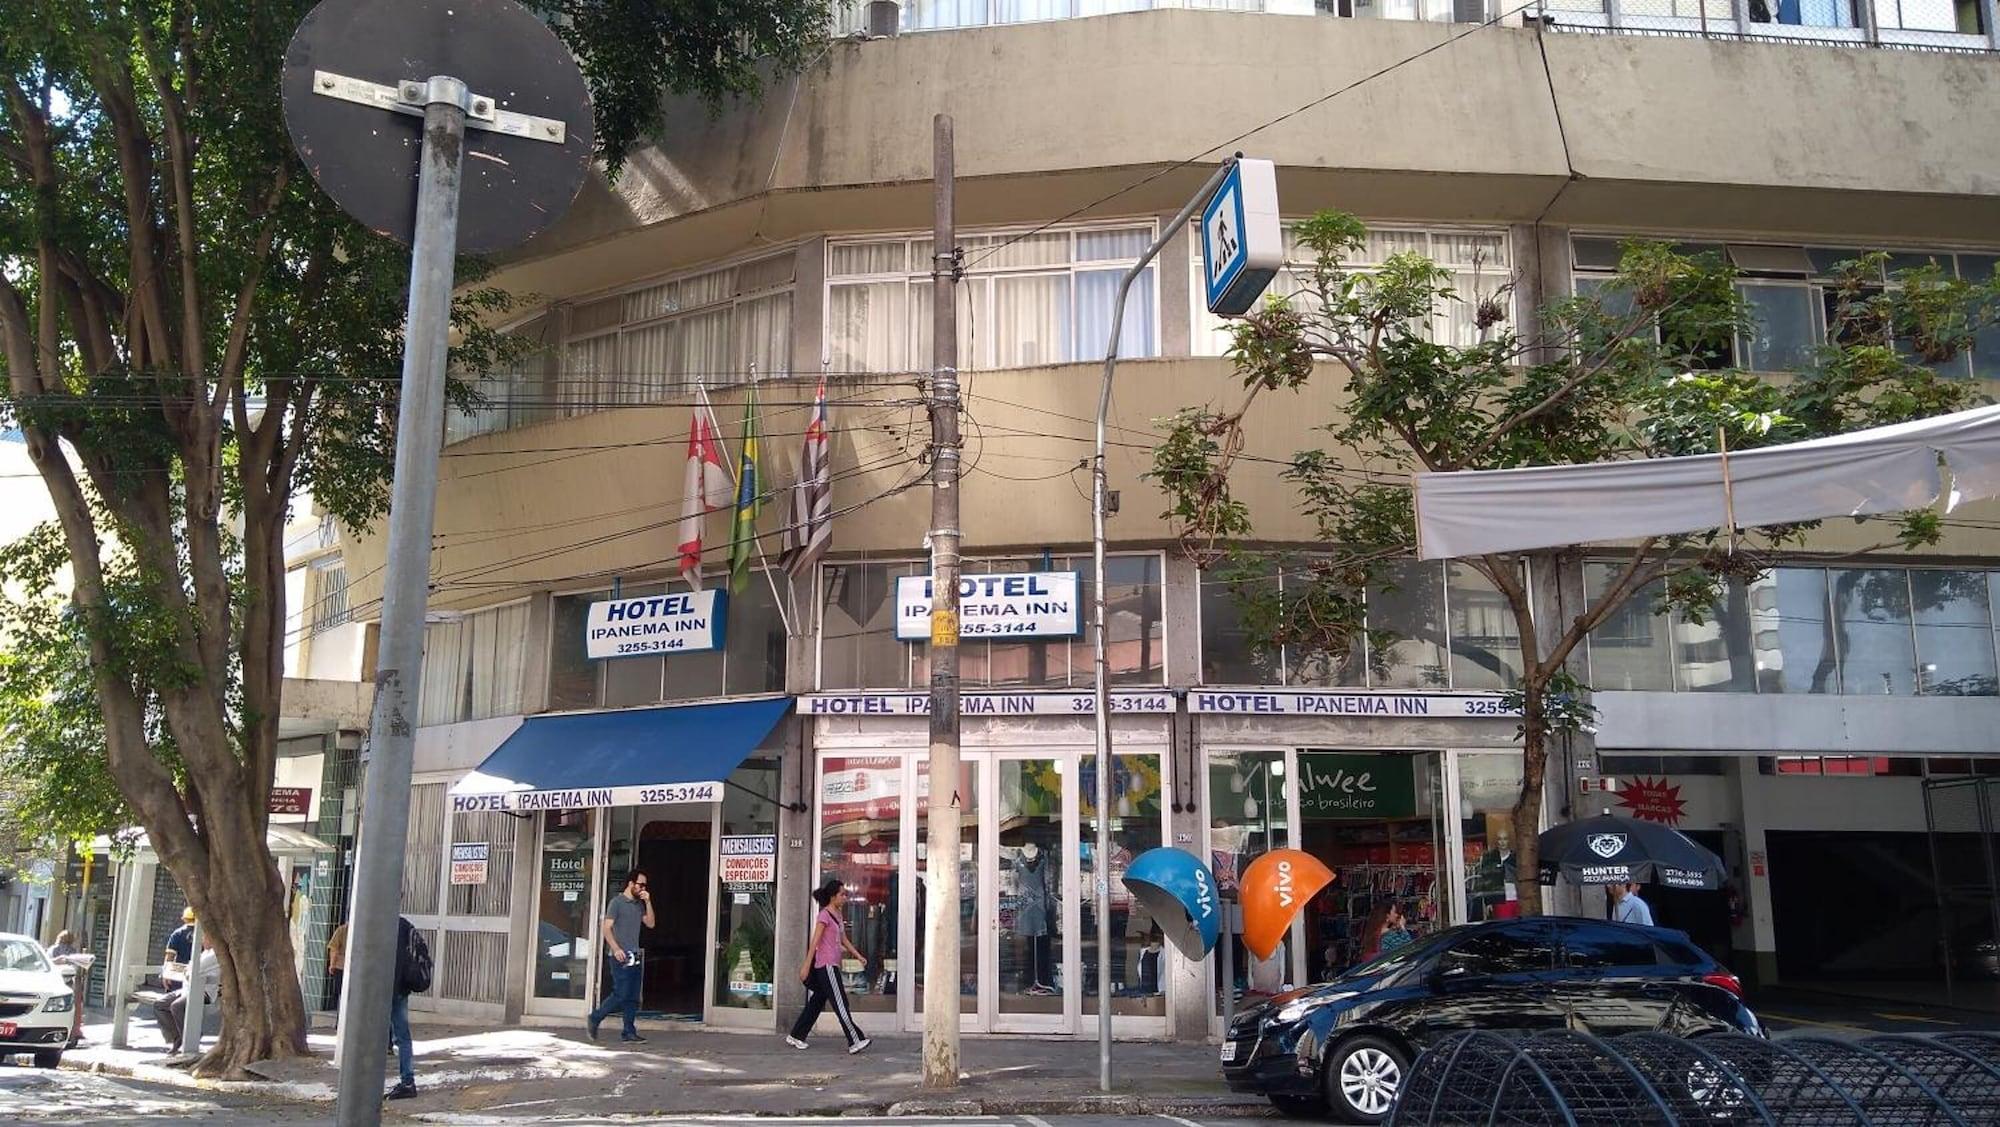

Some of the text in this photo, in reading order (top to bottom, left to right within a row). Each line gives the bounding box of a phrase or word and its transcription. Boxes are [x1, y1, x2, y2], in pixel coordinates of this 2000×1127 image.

[607, 596, 695, 621] HOTEL
[905, 602, 1068, 617] IPEMA INN
[591, 619, 706, 640] IPANEMA INN
[959, 622, 1037, 634] 55-3144
[618, 639, 684, 653] 3255-3144
[811, 697, 1167, 713] HOTEL IPAMA INN 325-3144
[1199, 695, 1285, 712] HOTEL
[1296, 697, 1389, 714] IPANEMA
[1394, 698, 1428, 714] INN
[453, 786, 713, 812] HOTEL IPANEMA INN 3255-3144
[722, 838, 774, 854] MENSALISTAS
[551, 858, 585, 869] Hotel
[726, 858, 769, 869] CONDIÇÕES
[1582, 866, 1630, 876] HUNTER
[1273, 860, 1294, 907] vivo
[1195, 868, 1213, 919] vivo
